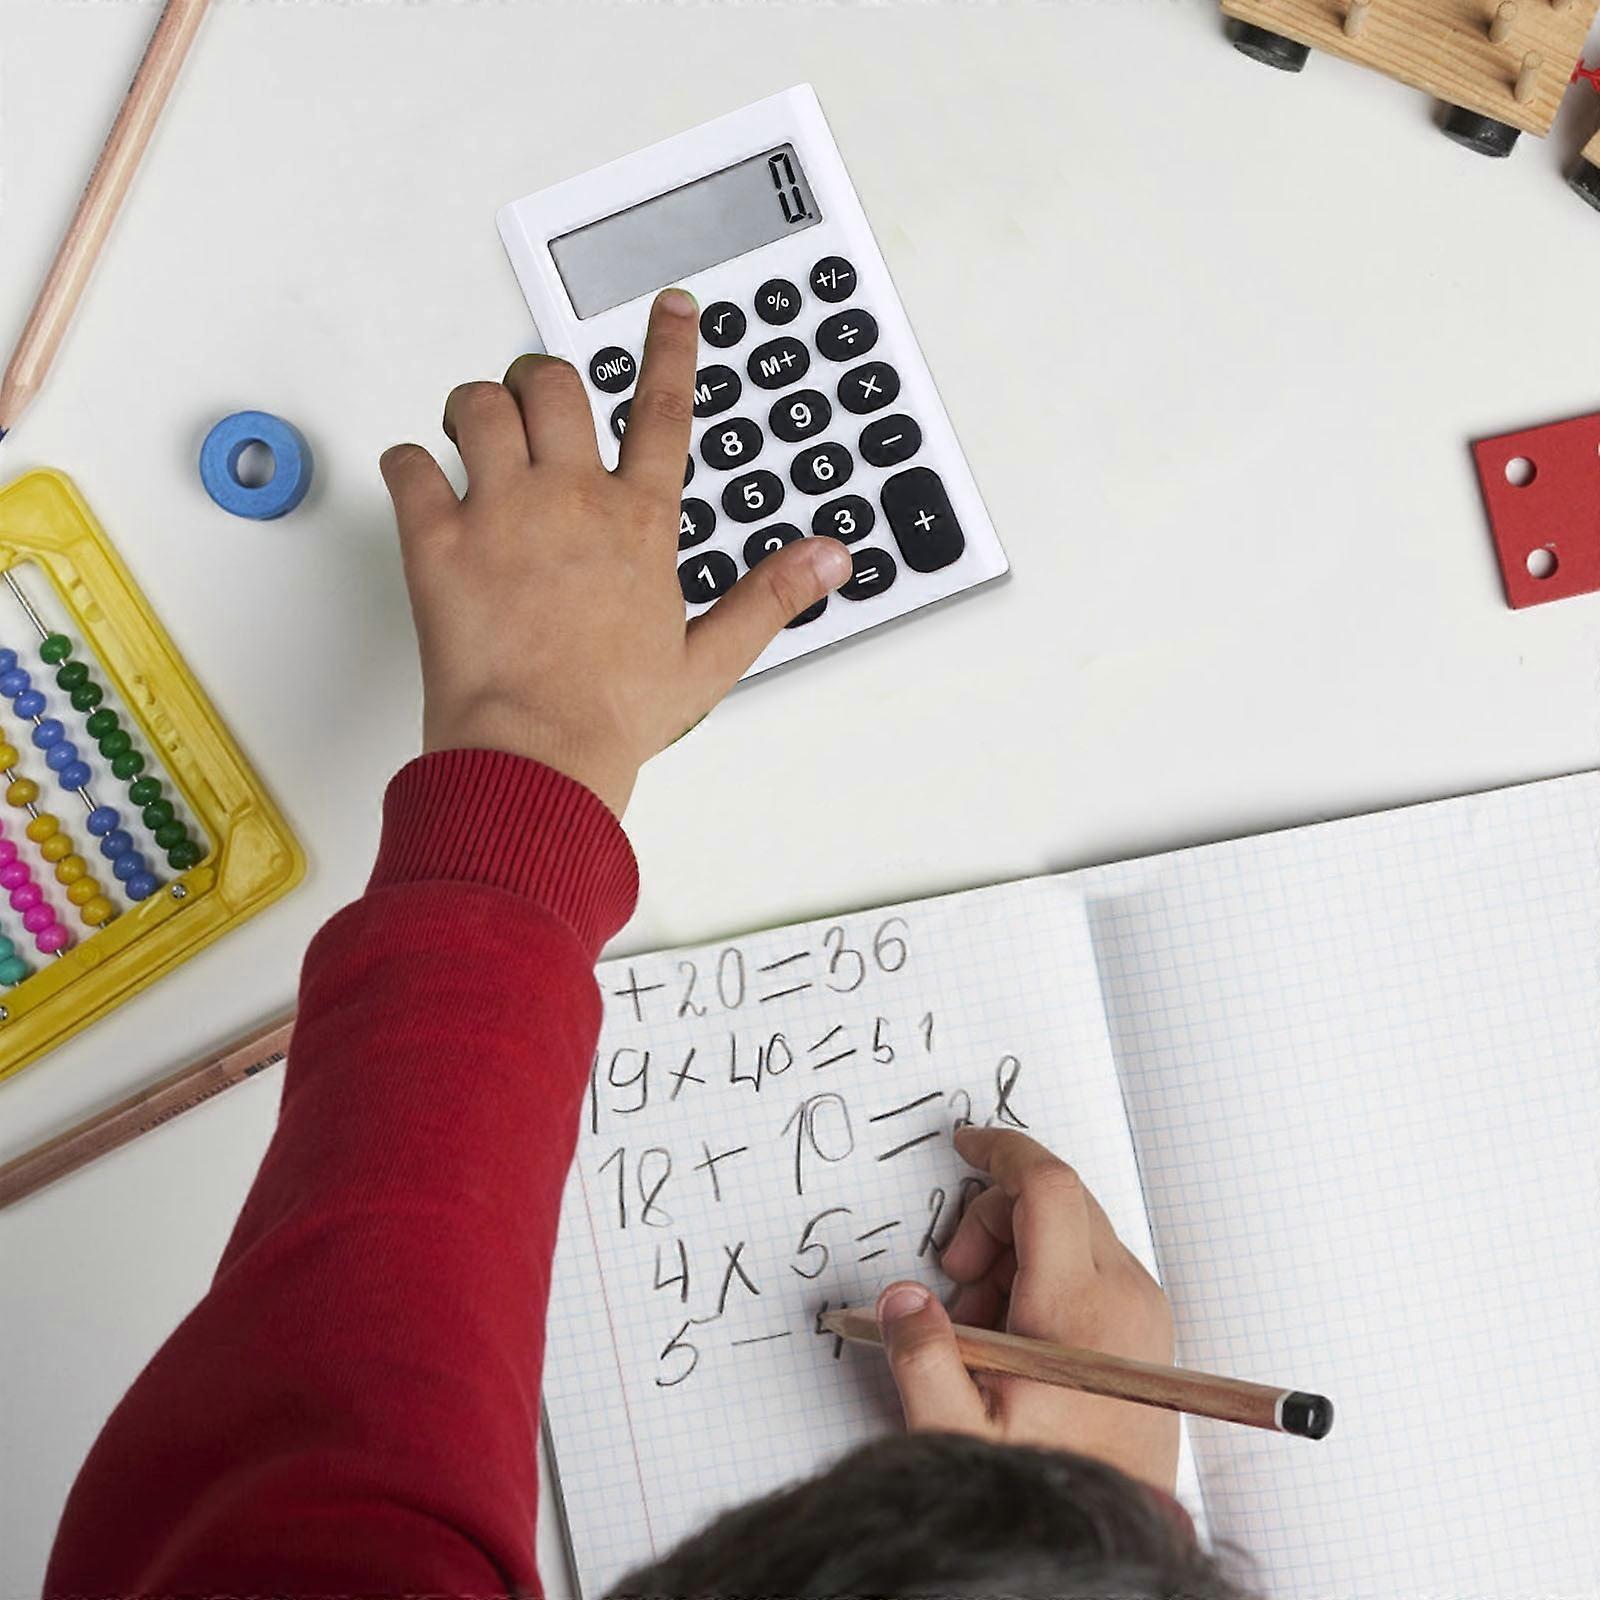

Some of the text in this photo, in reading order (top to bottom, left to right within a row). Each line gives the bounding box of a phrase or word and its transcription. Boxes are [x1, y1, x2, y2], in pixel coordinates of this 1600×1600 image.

[595, 355, 631, 381] ON/C
[767, 291, 790, 311] %
[759, 350, 797, 378] M+
[720, 431, 744, 457] 8
[789, 402, 812, 428] 9
[679, 511, 697, 536] 4
[743, 482, 764, 509] 5
[812, 454, 835, 481] 6
[697, 564, 716, 589] 1
[834, 509, 856, 534] 3
